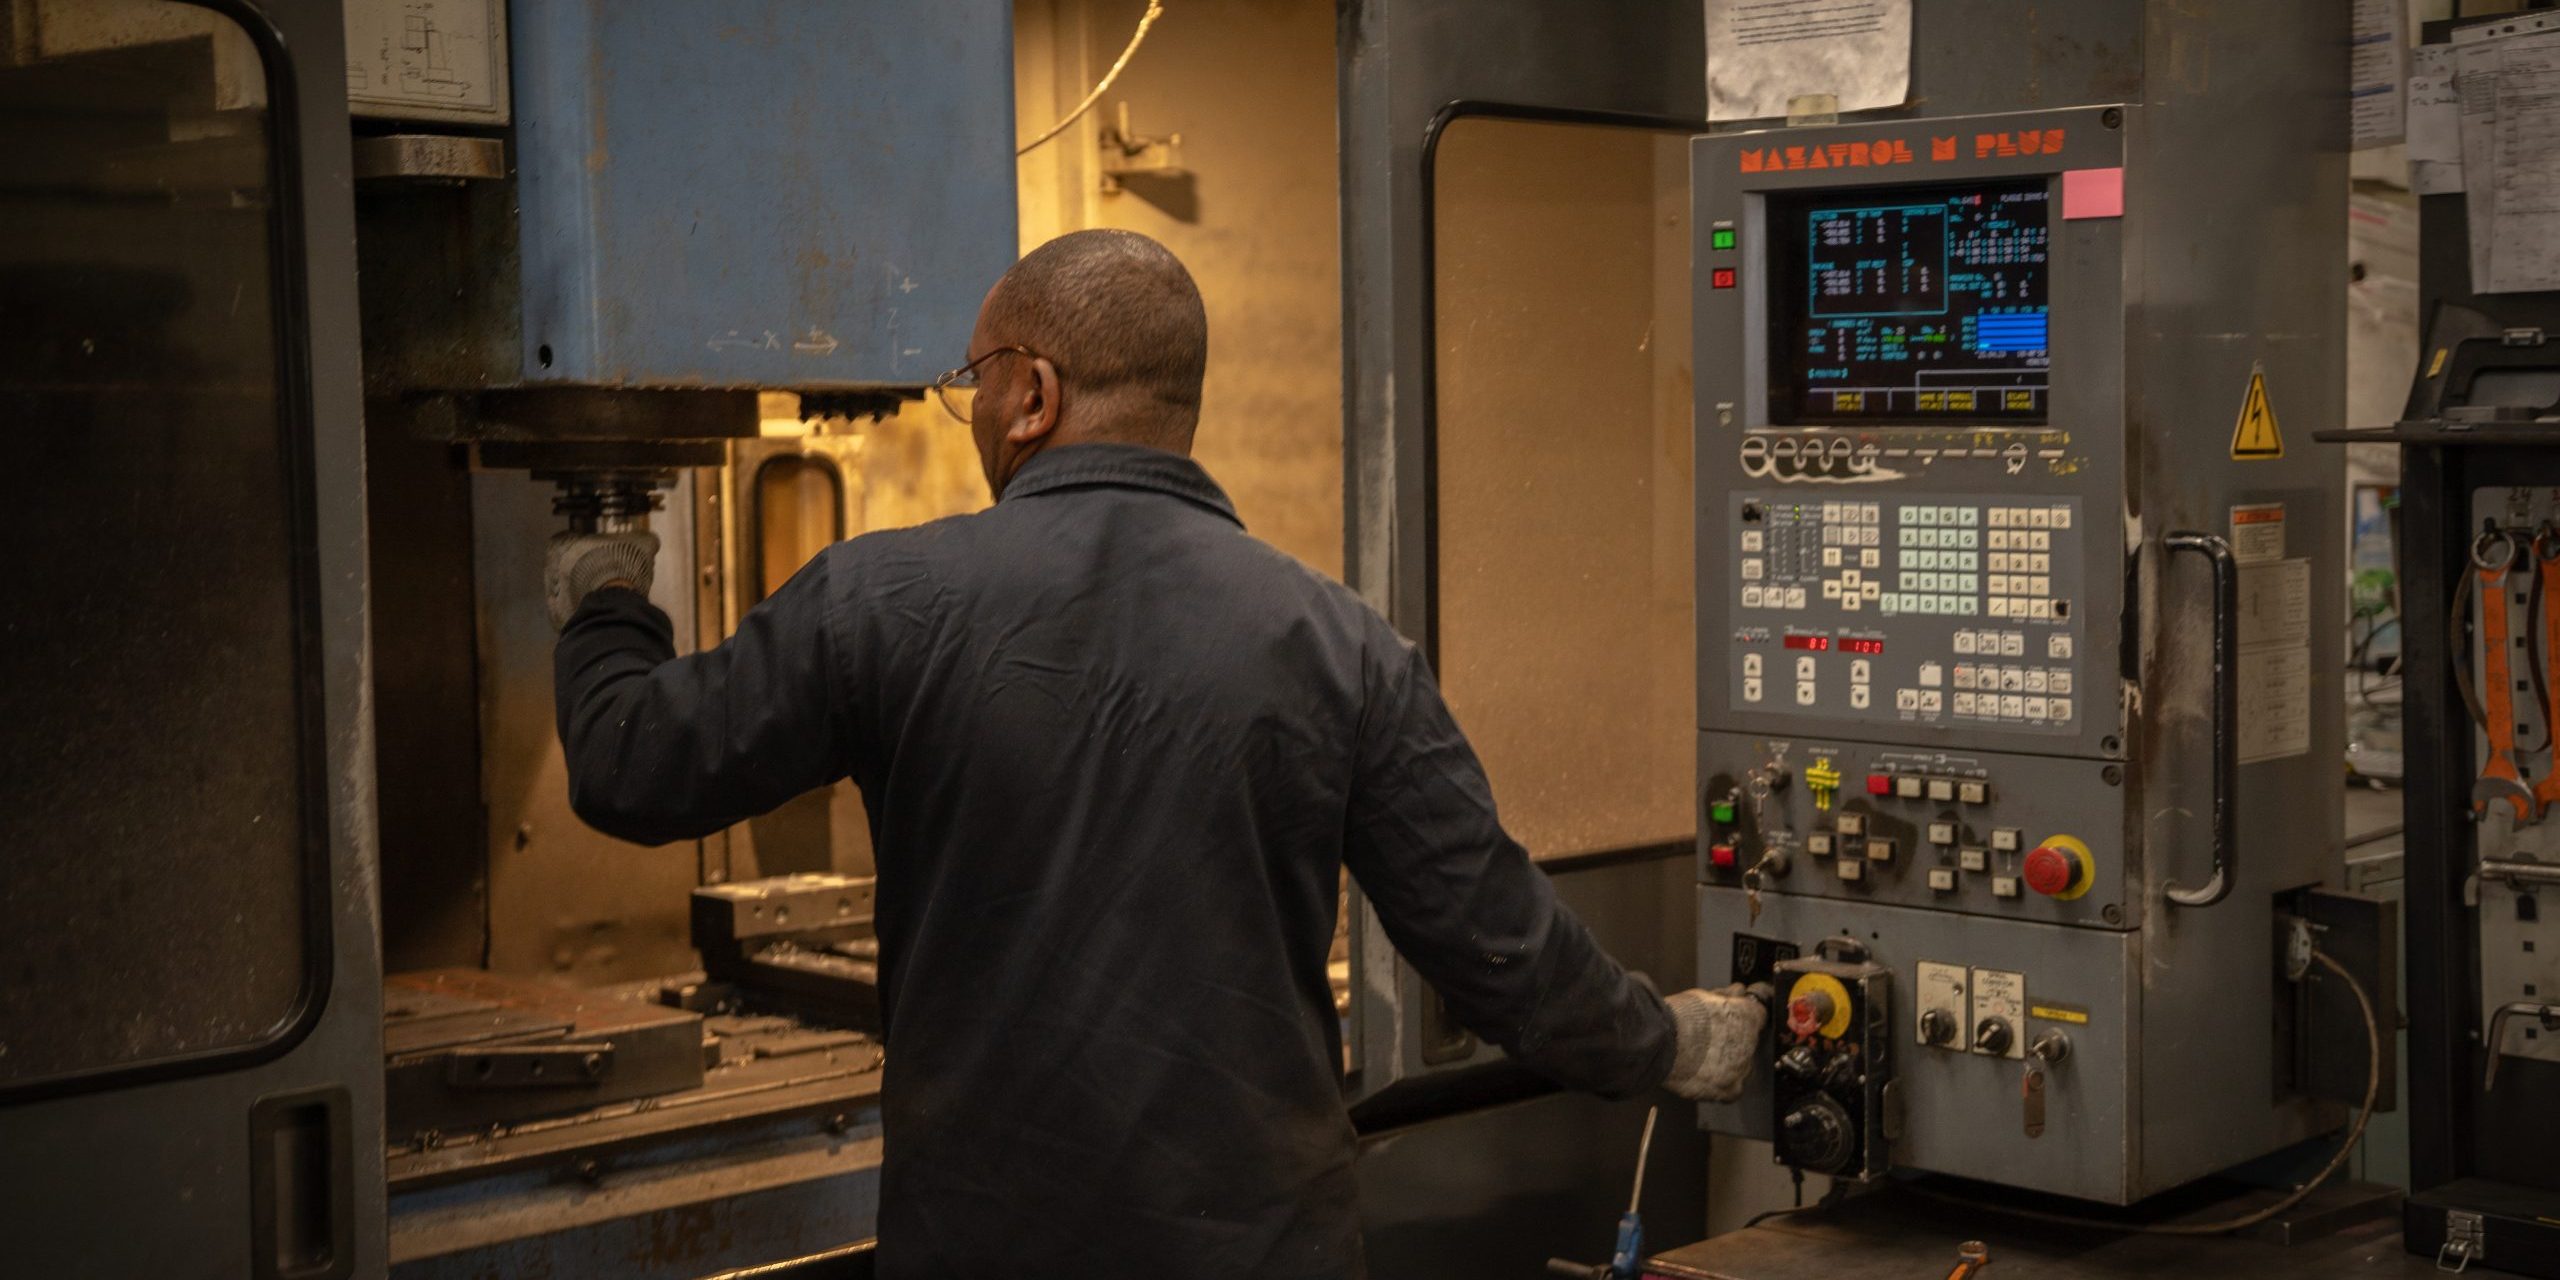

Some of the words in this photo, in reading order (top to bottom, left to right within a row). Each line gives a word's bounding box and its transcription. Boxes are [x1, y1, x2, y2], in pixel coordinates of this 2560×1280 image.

[1739, 139, 1913, 173] MAZATROL
[1932, 136, 1957, 161] M
[1976, 129, 2064, 158] PLUS
[1809, 638, 1827, 649] 80
[1856, 642, 1880, 653] 100
